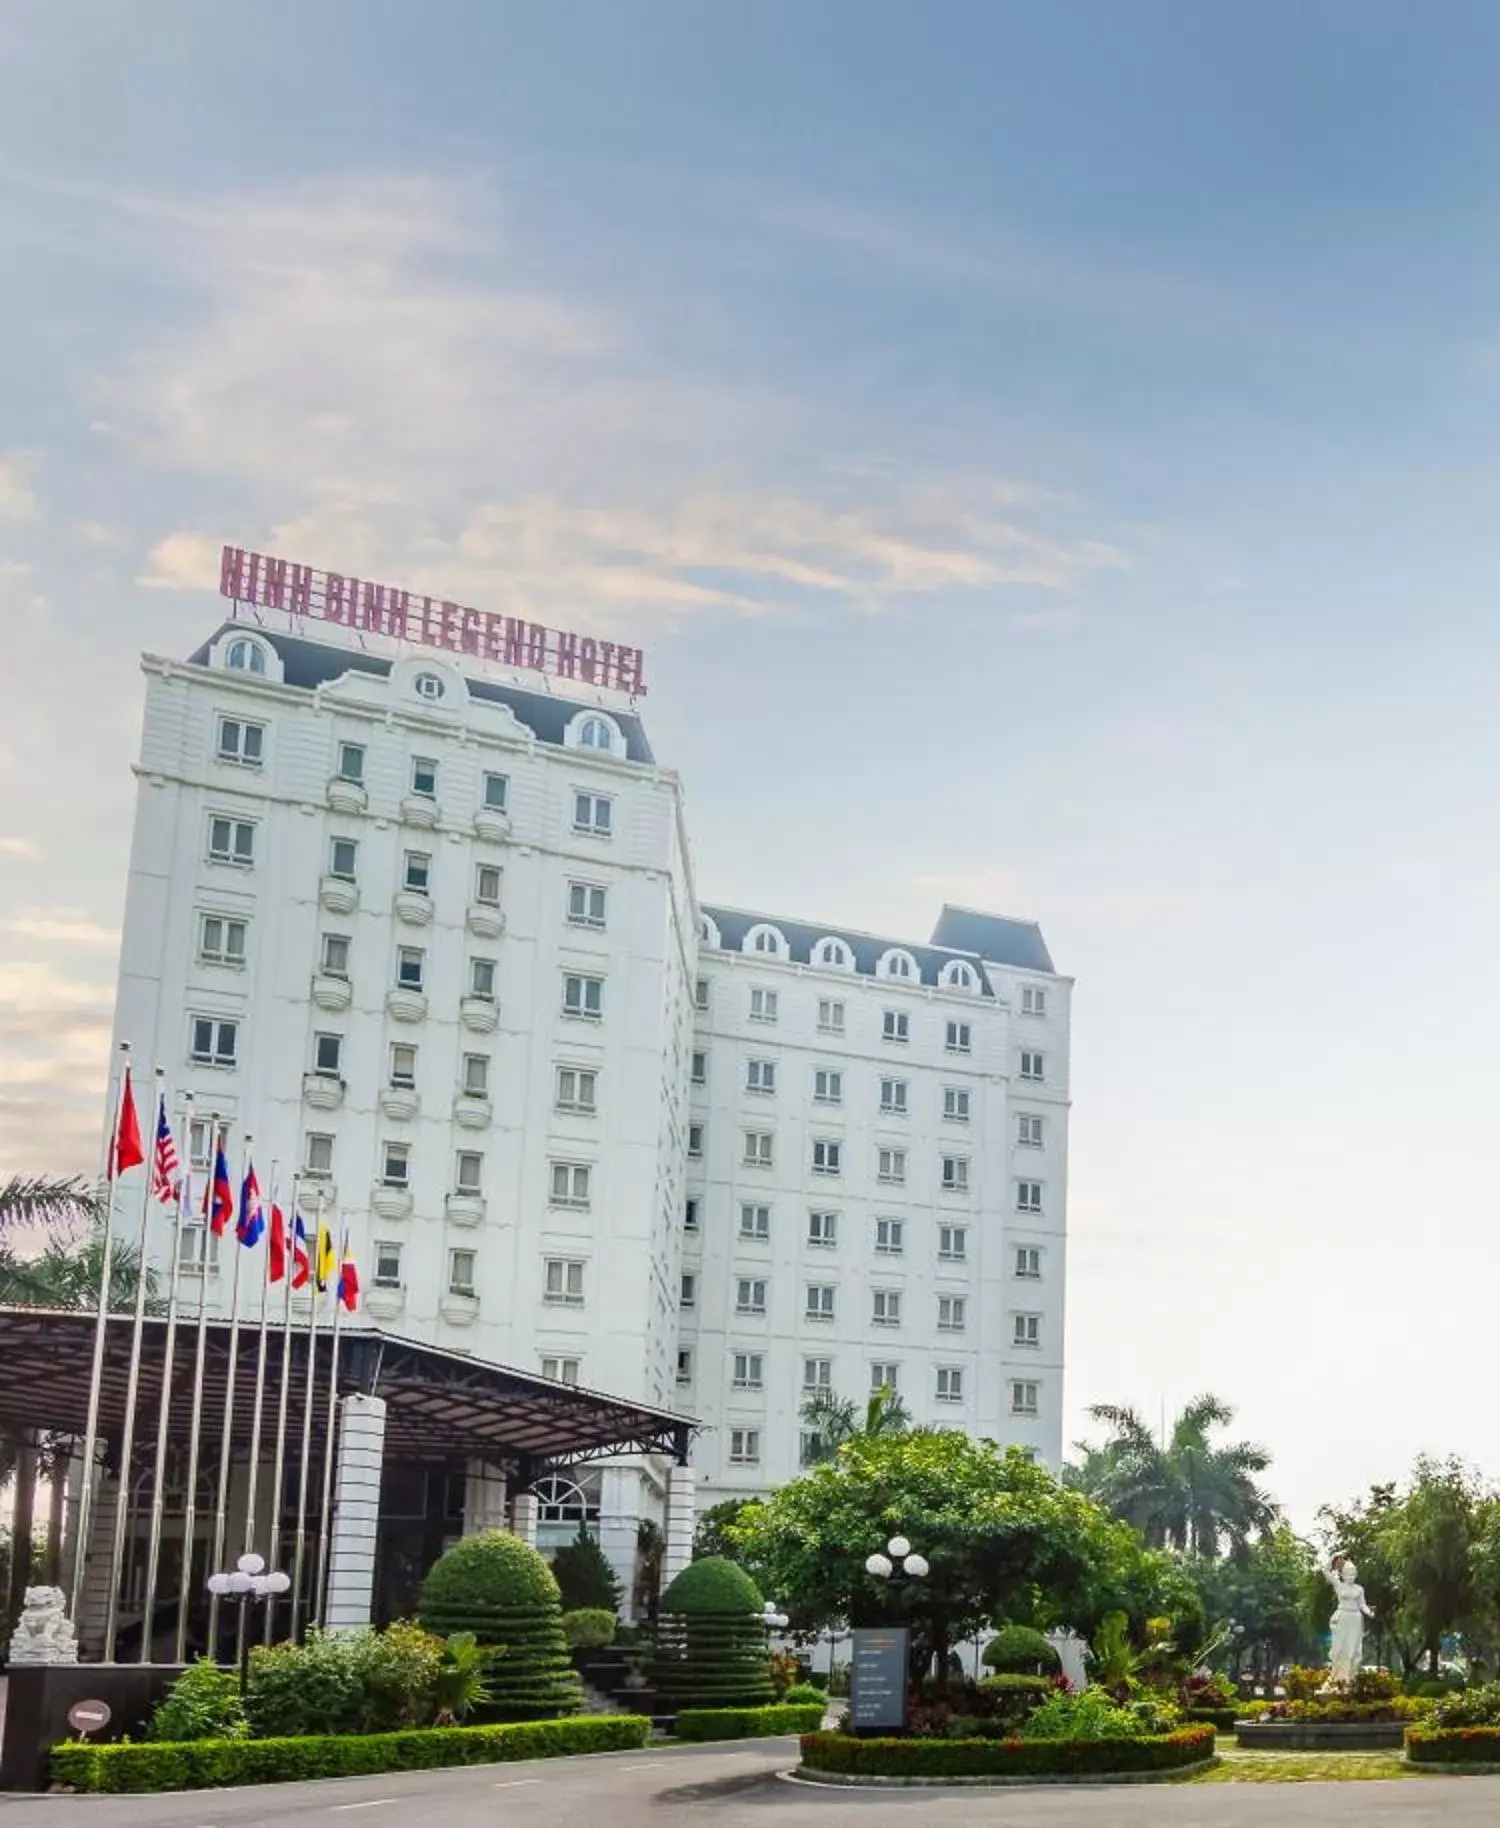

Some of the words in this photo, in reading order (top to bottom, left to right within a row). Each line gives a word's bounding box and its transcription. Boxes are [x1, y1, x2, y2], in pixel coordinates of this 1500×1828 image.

[220, 545, 311, 616] NINH
[324, 571, 408, 639] BINH
[421, 597, 546, 672] LEGEND
[558, 631, 648, 697] HOTEL
